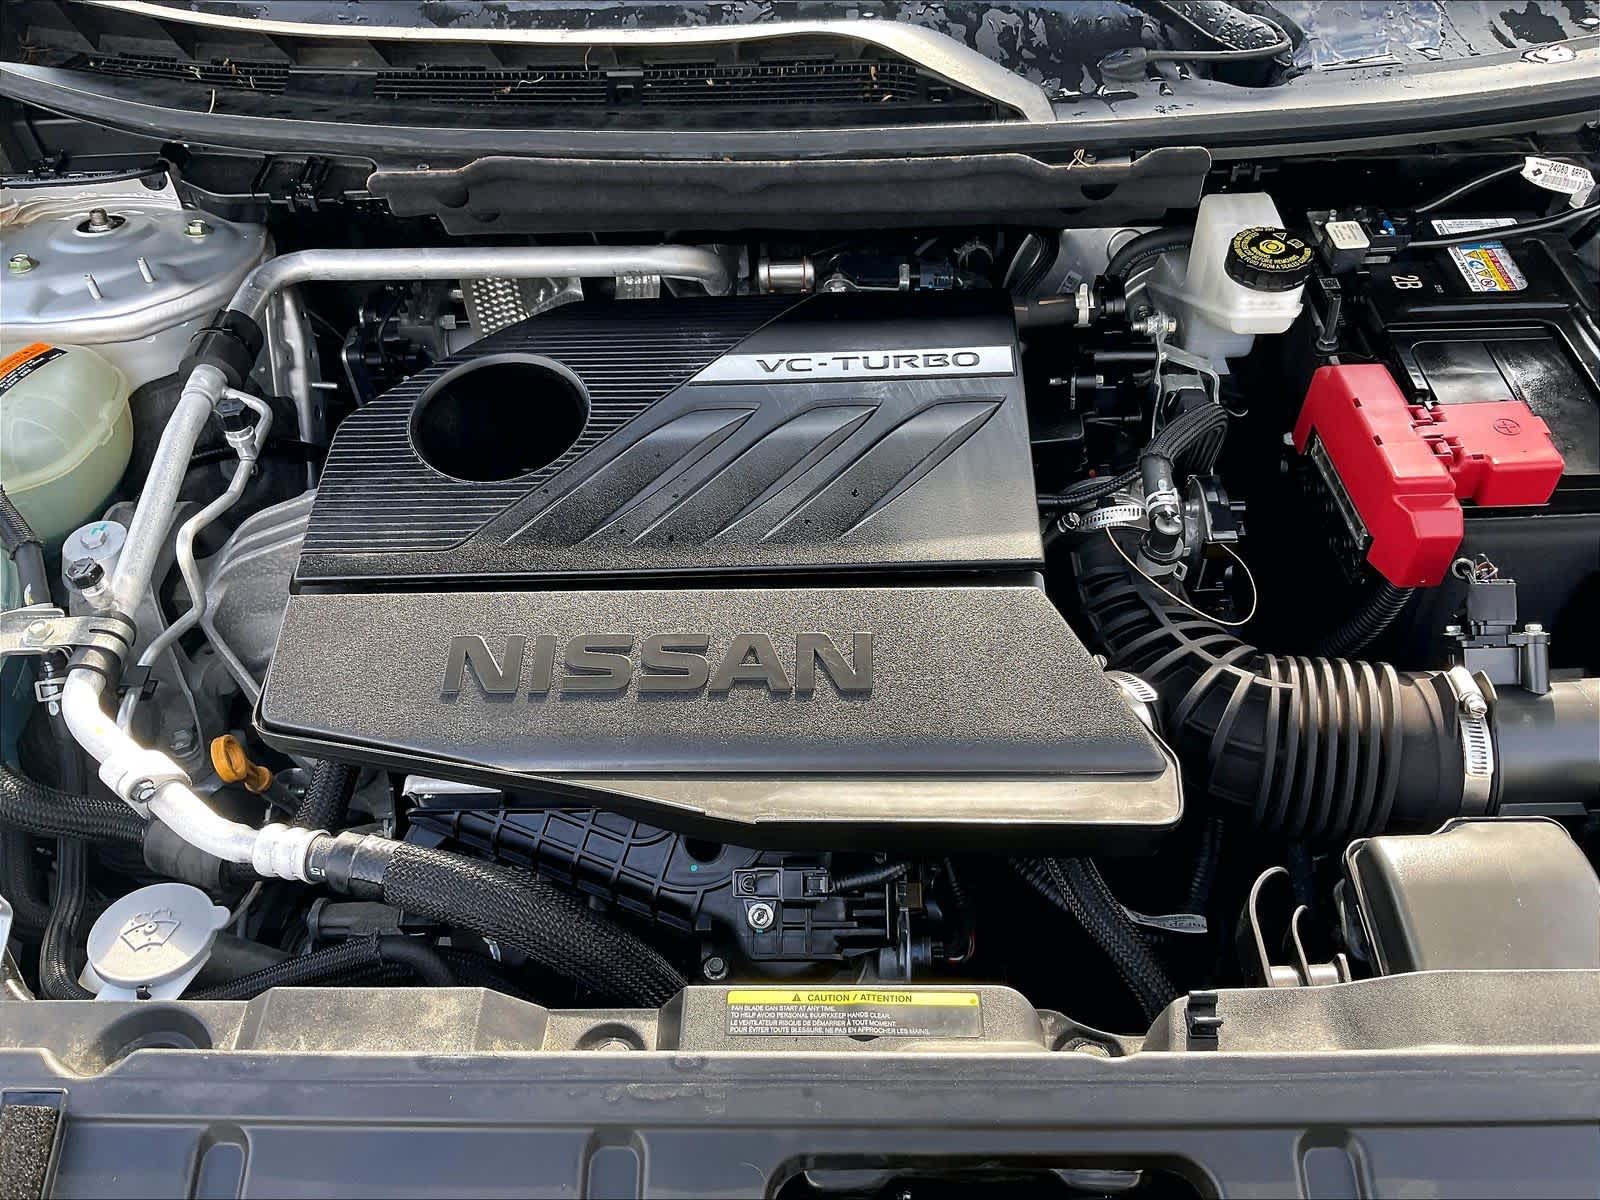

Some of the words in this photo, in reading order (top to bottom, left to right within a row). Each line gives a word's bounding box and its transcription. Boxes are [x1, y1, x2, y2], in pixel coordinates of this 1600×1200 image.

[1391, 275, 1423, 289] 2B
[756, 351, 980, 373] VC-TURBO
[442, 631, 873, 695] NISSAN
[807, 994, 850, 1002] CAUTION
[860, 994, 912, 1003] ATTENTION
[858, 1026, 896, 1034] APPROCHER
